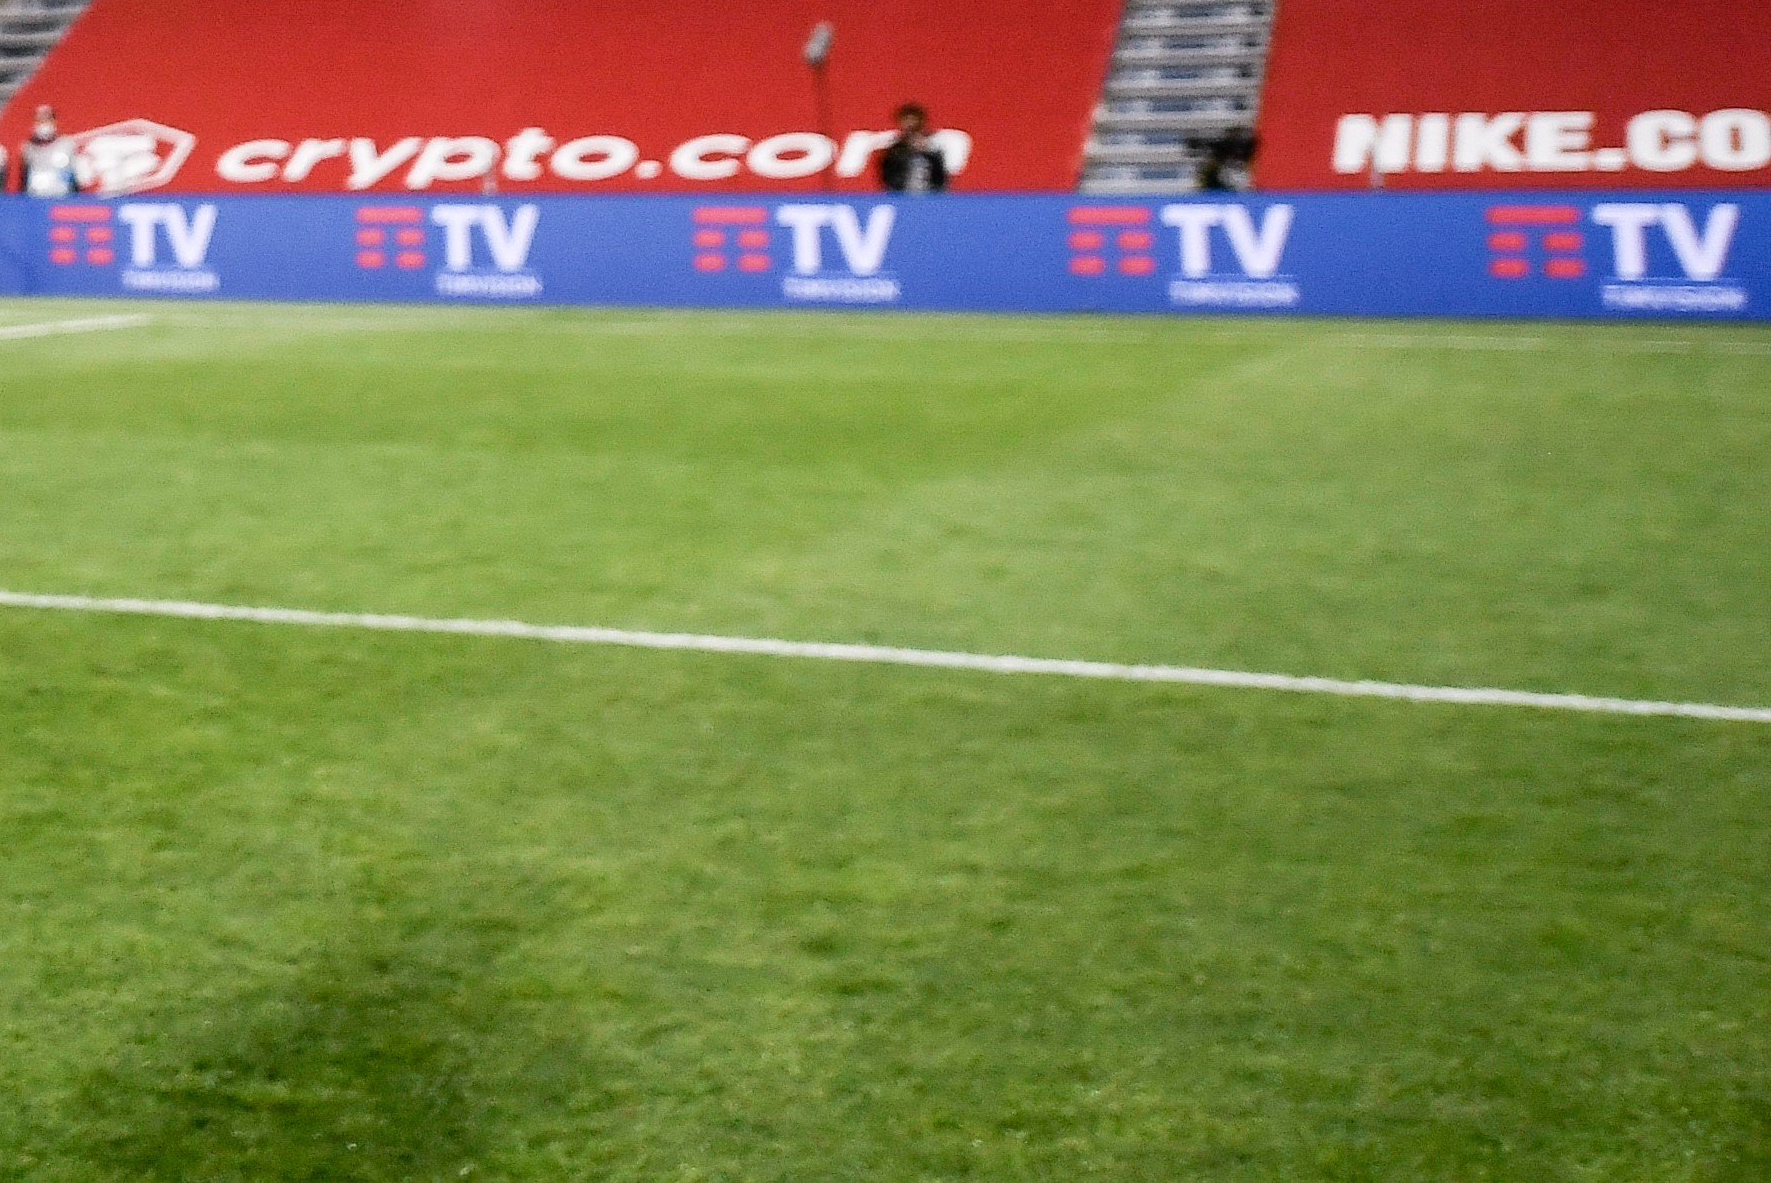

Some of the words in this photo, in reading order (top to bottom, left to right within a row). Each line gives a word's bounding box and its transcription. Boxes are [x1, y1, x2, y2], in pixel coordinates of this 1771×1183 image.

[215, 126, 974, 191] crypto.com
[1331, 108, 1771, 175] NIKE.CO
[117, 202, 218, 268] TV
[430, 202, 540, 273] TV
[776, 203, 897, 276] TV
[1160, 203, 1295, 279] TV
[1589, 202, 1739, 282] TV
